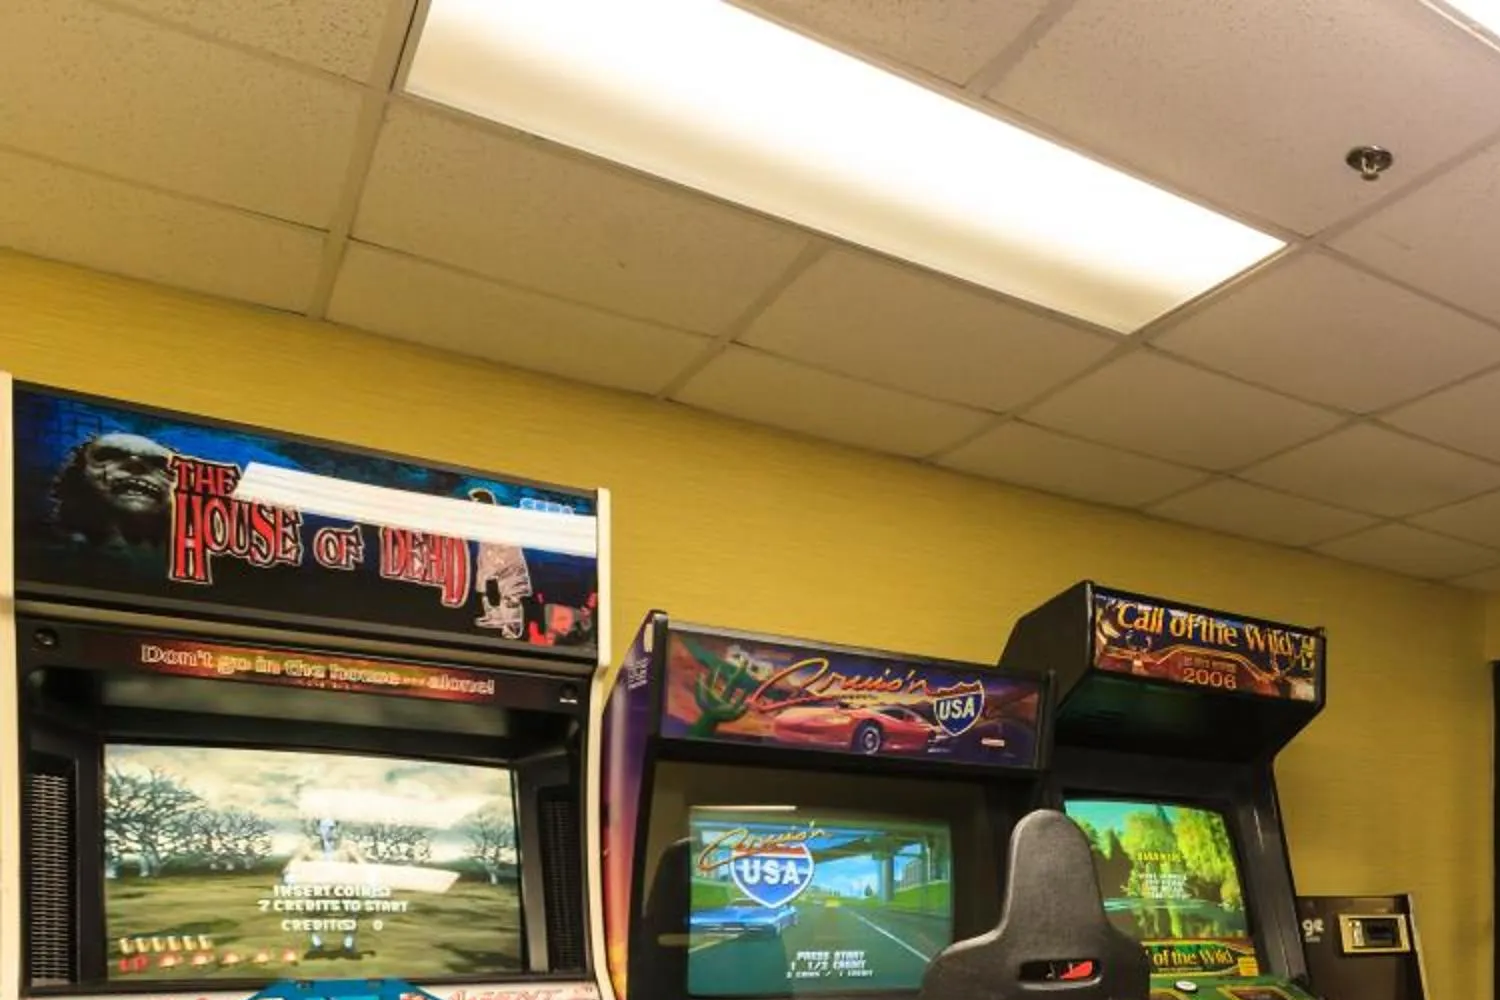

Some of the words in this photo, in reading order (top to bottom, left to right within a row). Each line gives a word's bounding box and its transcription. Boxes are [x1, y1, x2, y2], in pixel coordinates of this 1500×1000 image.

[168, 454, 241, 497] THE
[170, 491, 303, 583] HOUSE
[313, 526, 364, 570] OF
[379, 525, 471, 607] DEAD
[1117, 602, 1164, 636] Call
[1169, 611, 1200, 640] of
[1199, 616, 1238, 647] the
[1243, 624, 1296, 657] Wild
[141, 644, 213, 668] Don't
[217, 656, 251, 675] go
[255, 656, 281, 674] in
[284, 660, 326, 678] the
[939, 697, 976, 720] USA
[743, 859, 801, 885] USA
[273, 885, 330, 897] INSERT
[365, 901, 409, 912] START
